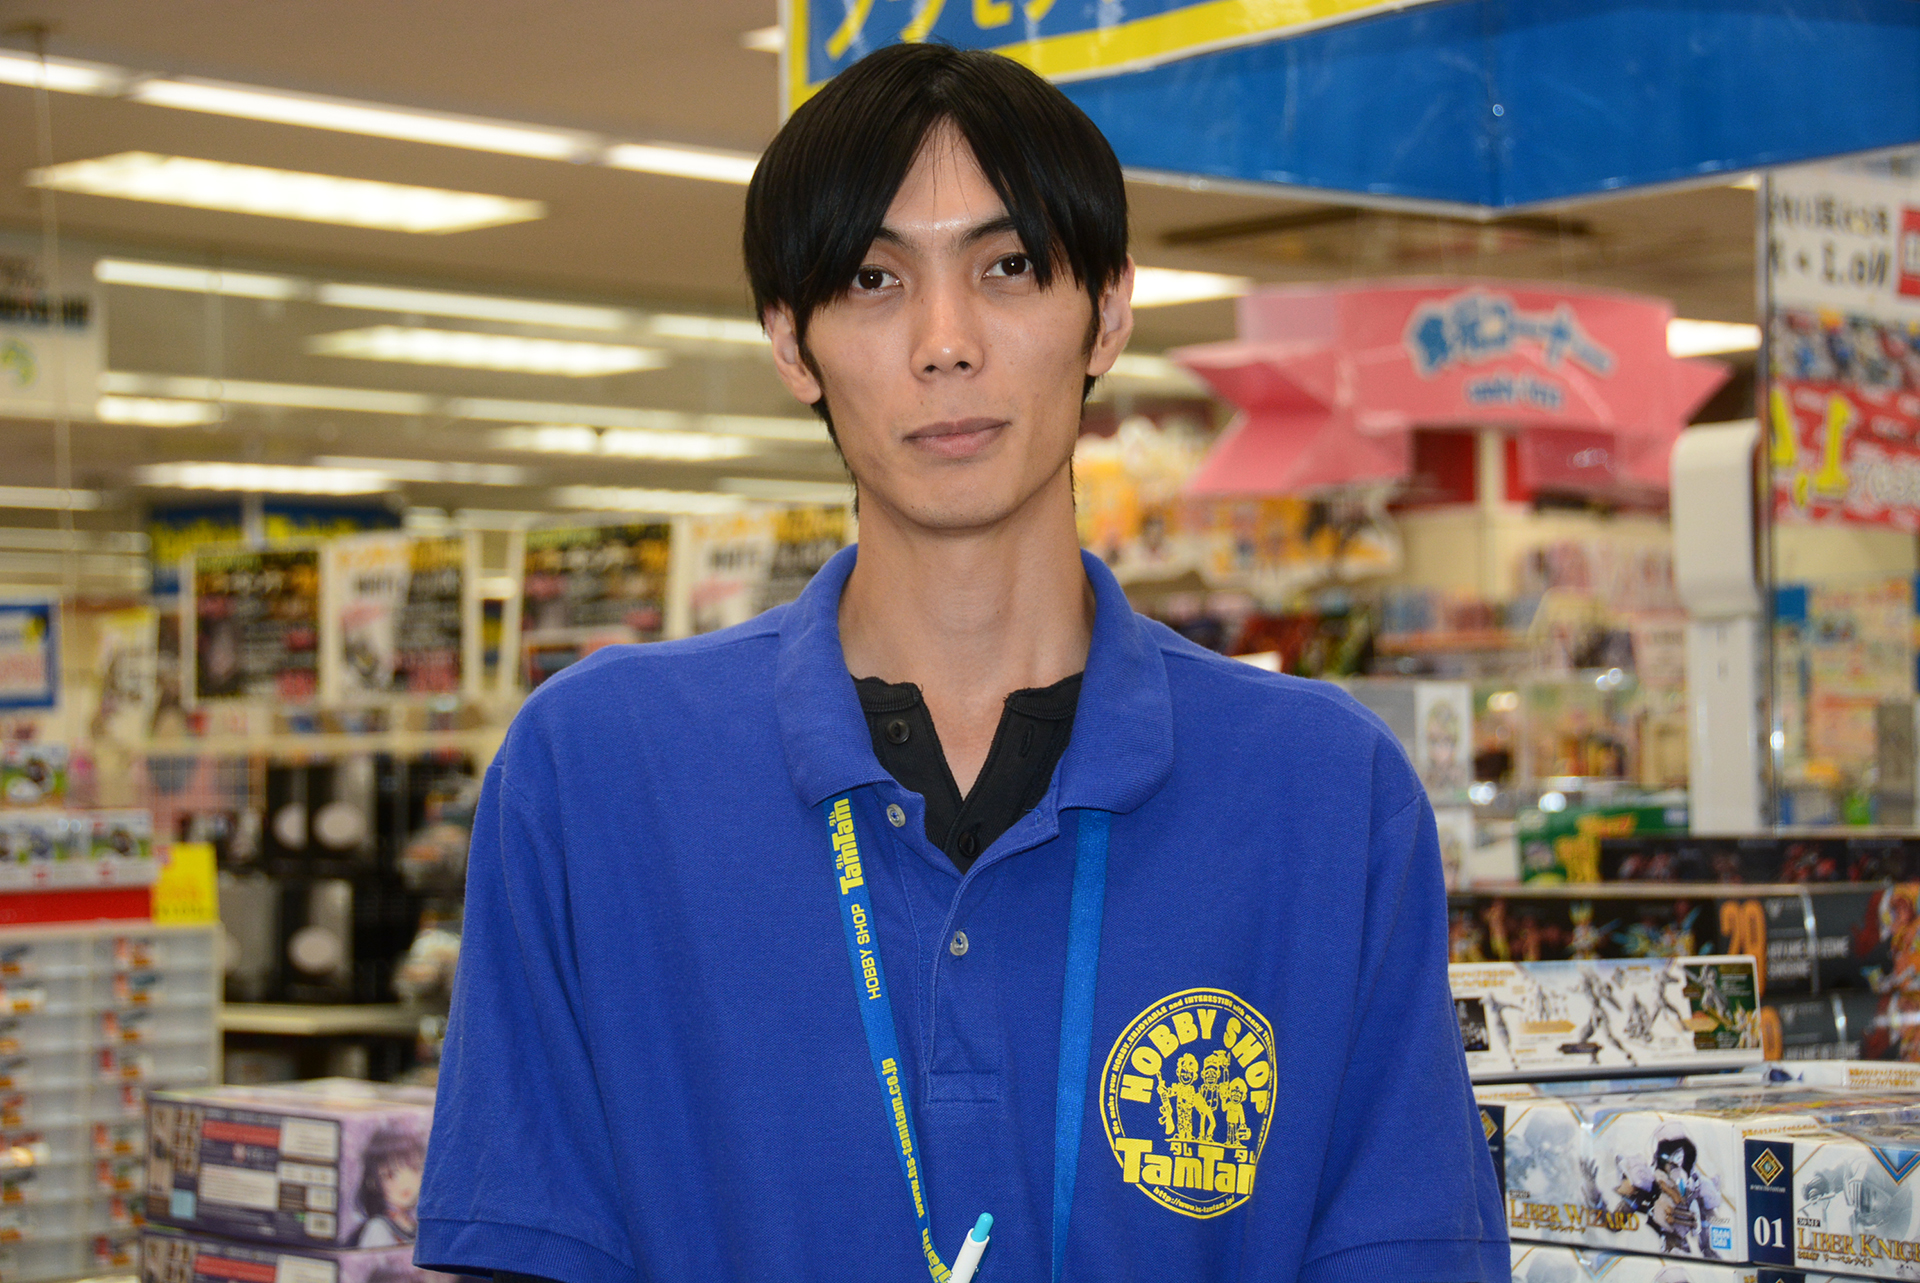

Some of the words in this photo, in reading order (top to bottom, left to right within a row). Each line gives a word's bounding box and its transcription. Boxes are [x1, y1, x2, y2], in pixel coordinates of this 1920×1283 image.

[832, 798, 865, 895] TamTam
[851, 903, 871, 945] SHOP
[860, 949, 882, 1000] HOBBY
[1168, 999, 1184, 1011] and
[1244, 1014, 1264, 1033] many
[1120, 1009, 1217, 1103] HOBBY
[1224, 1017, 1269, 1113] SHOP
[1510, 1199, 1562, 1223] LIBER
[1563, 1203, 1640, 1232] WIZARD
[1753, 1215, 1786, 1249] 01
[1797, 1227, 1856, 1256] LIBER
